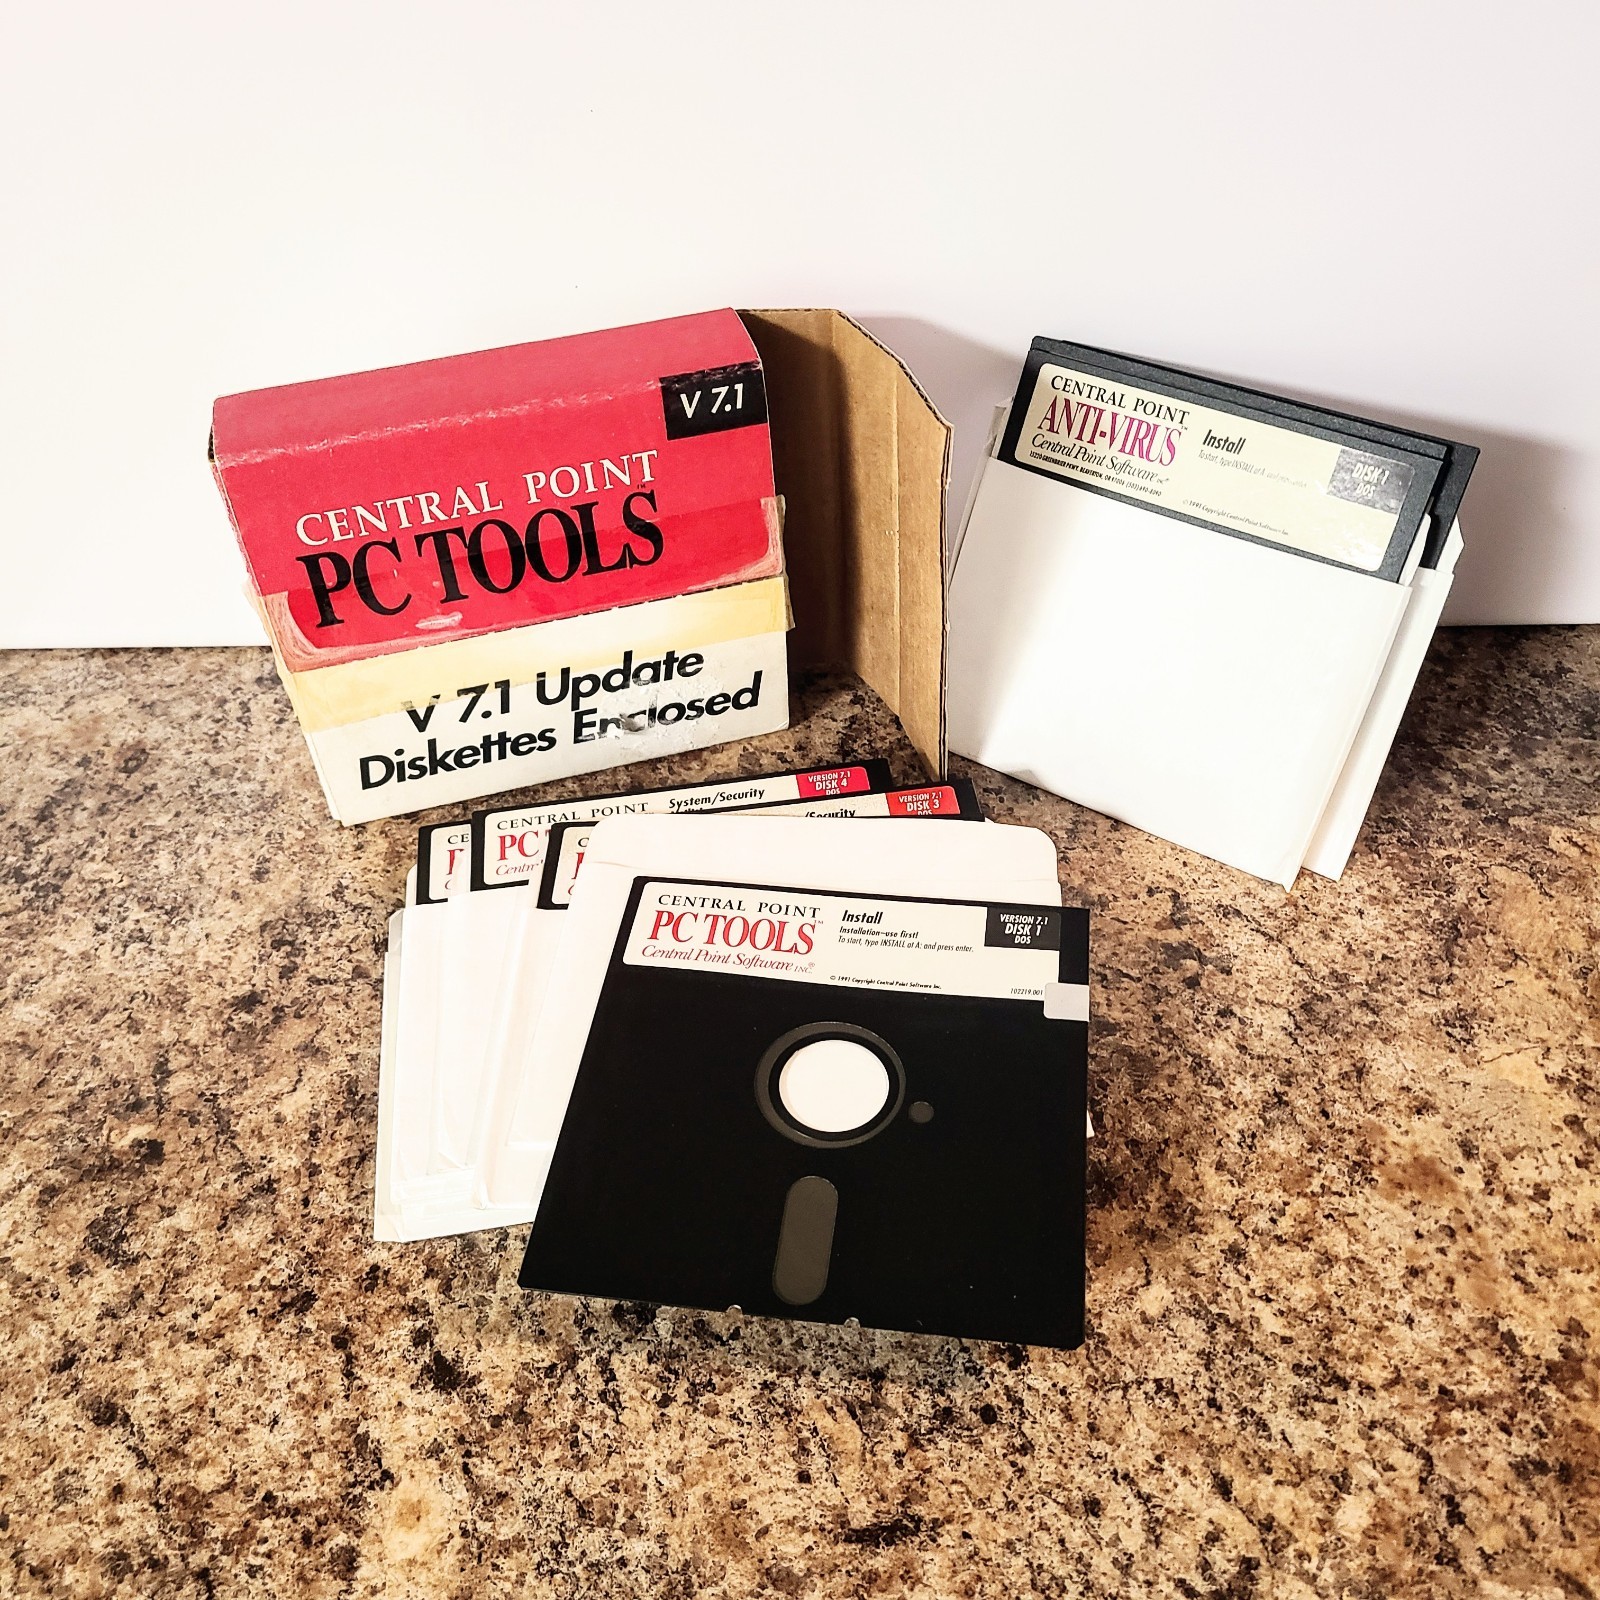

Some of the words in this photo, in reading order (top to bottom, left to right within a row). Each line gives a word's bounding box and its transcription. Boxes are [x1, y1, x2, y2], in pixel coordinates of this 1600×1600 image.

[680, 391, 702, 419] V
[711, 383, 744, 414] 7.1
[1050, 375, 1127, 408] CENTRAL
[1132, 397, 1190, 425] POINT
[1037, 394, 1182, 467] ANTI-VIRUS
[1202, 429, 1247, 455] Install
[1031, 433, 1076, 458] Central
[1073, 446, 1107, 468] Point
[1106, 455, 1158, 482] Software
[1232, 459, 1255, 474] INSTALL
[1351, 462, 1382, 483] DISK
[1380, 470, 1390, 486] 1
[295, 481, 503, 546] CENTRAL
[522, 449, 659, 504] POINT
[1355, 483, 1376, 500] DOS
[295, 537, 413, 628] PC
[413, 489, 664, 604] TOOLS
[401, 694, 441, 733] V
[457, 678, 511, 724] 7.1
[535, 650, 705, 711] Update
[359, 727, 557, 791] Diskettes
[807, 773, 839, 783] VERSION
[840, 770, 851, 779] 7.1
[815, 780, 838, 791] DISK
[840, 777, 848, 787] 4
[669, 788, 765, 813] System/Security
[825, 788, 841, 796] DOS
[898, 792, 930, 803] VERSION
[931, 791, 942, 799] 7.1
[497, 811, 581, 831] CENTRAL
[591, 802, 649, 818] POINT
[906, 800, 930, 812] DISK
[933, 799, 940, 808] 3
[497, 830, 540, 862] PC
[658, 894, 746, 912] CENTRAL
[757, 901, 821, 919] POINT
[841, 909, 883, 925] Install
[1000, 914, 1034, 925] VERSION
[1035, 916, 1048, 925] 7.1
[1004, 923, 1032, 936] DISK
[1036, 924, 1042, 936] 1
[647, 910, 699, 943] PC
[703, 913, 816, 955] TOOLS
[838, 935, 846, 943] To
[846, 937, 863, 946] start,
[864, 938, 879, 947] type
[880, 939, 905, 948] INSTALL
[906, 941, 915, 949] at
[914, 941, 922, 949] A:
[923, 942, 937, 950] and
[936, 944, 954, 952] press
[955, 945, 974, 953] enter.
[900, 930, 919, 939] first!
[1014, 935, 1032, 944] DOS
[641, 944, 695, 962] Central
[694, 948, 731, 965] Point
[732, 952, 794, 972] Software
[851, 977, 876, 985] Copyright
